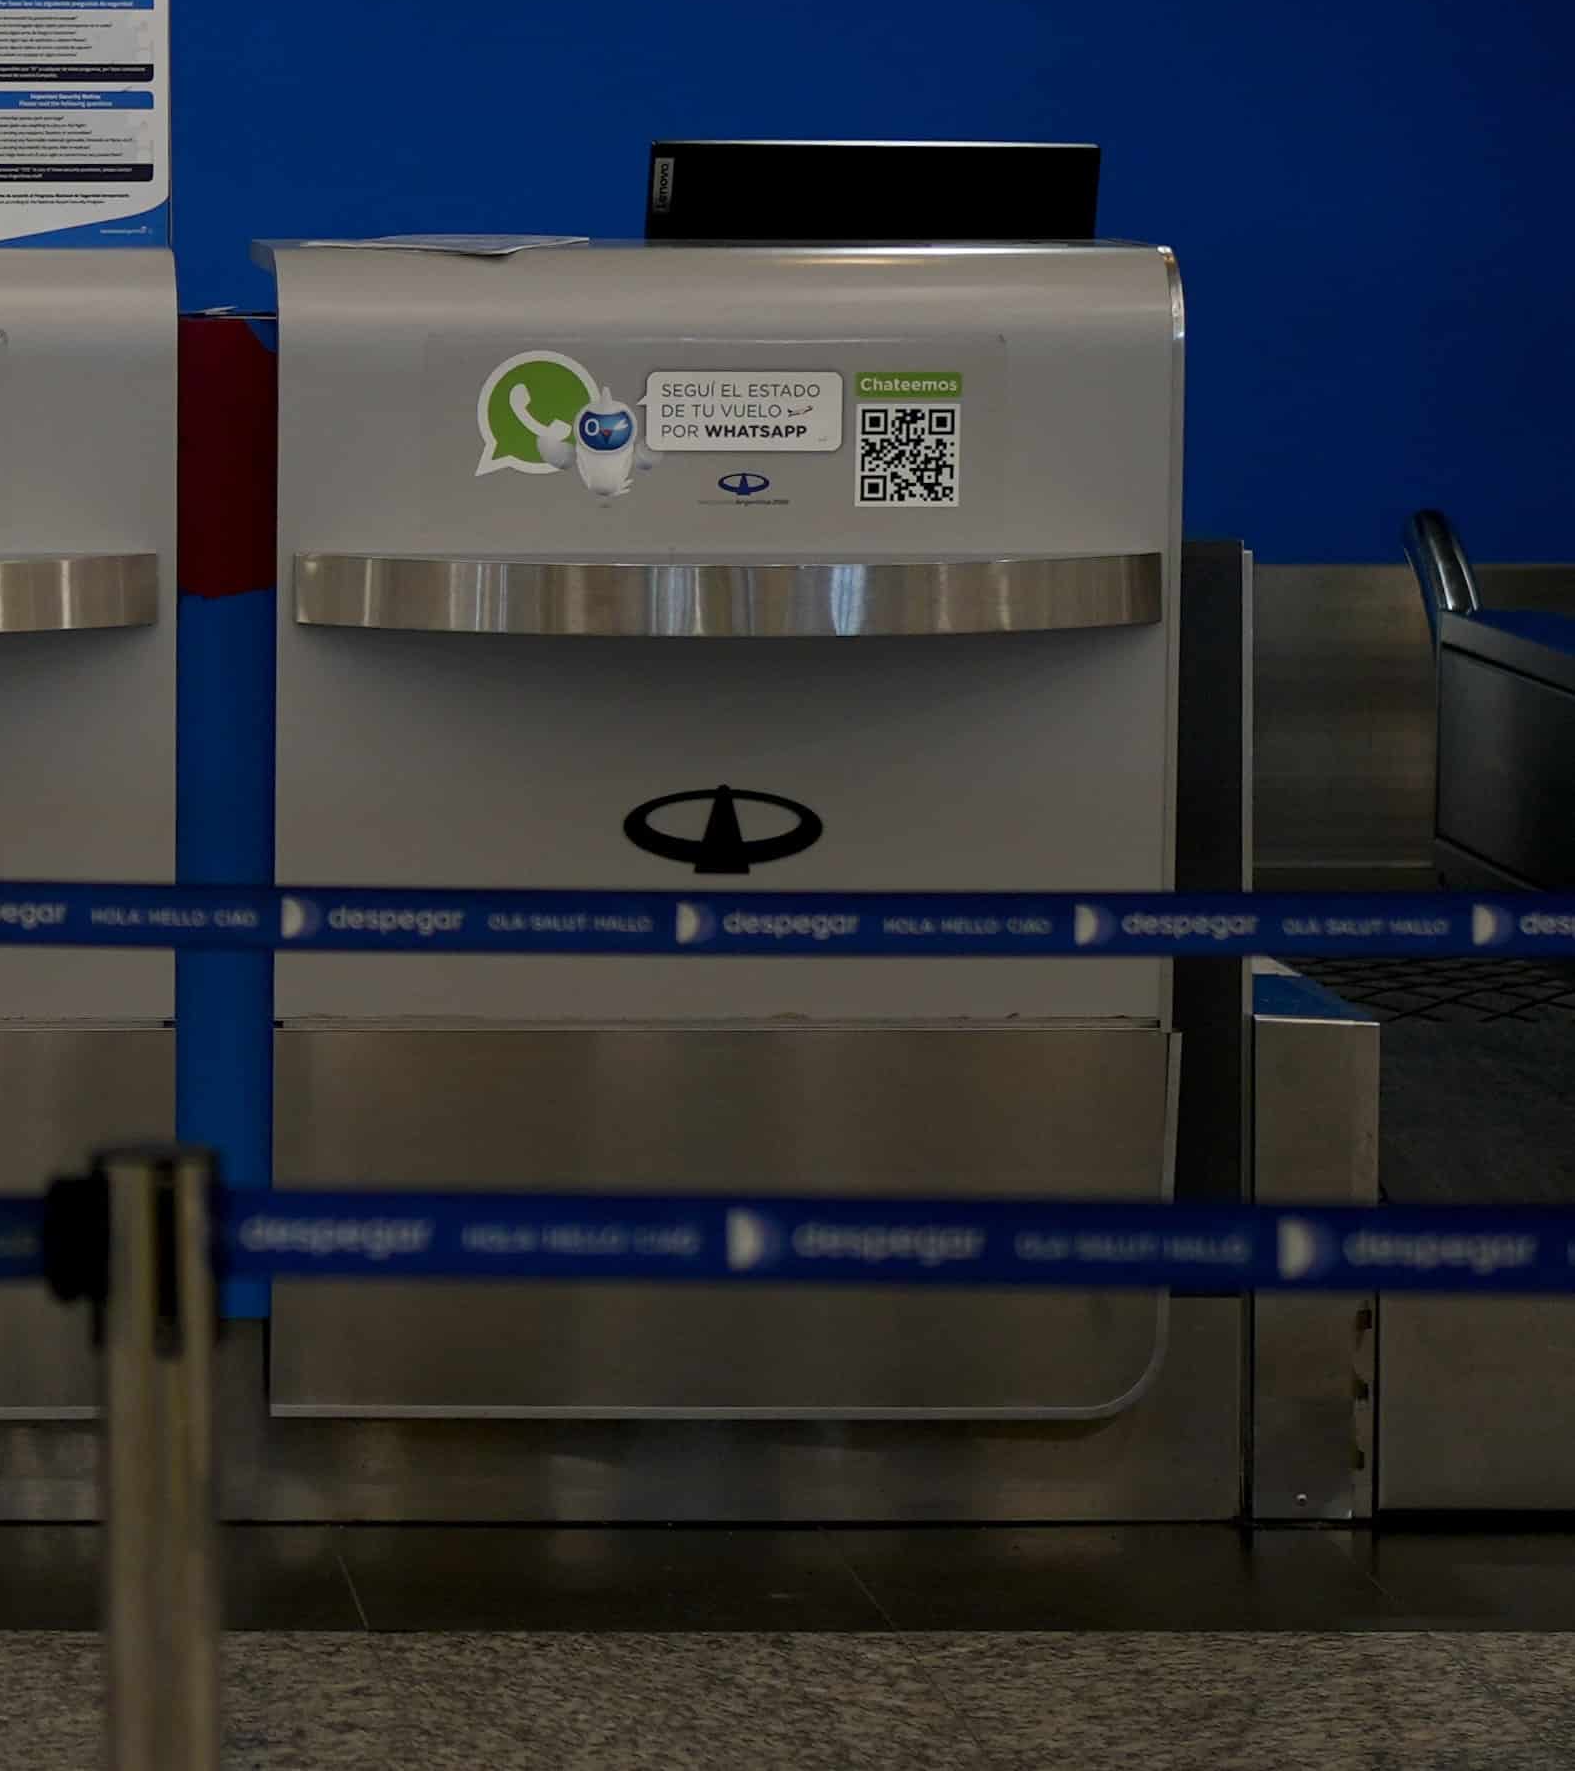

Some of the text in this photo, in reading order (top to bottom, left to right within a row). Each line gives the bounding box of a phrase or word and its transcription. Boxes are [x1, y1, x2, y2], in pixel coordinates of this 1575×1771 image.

[661, 382, 821, 399] SEGUÍ EL ESTADO
[860, 375, 957, 394] Chateemos
[661, 404, 782, 419] DE TU VUELO
[662, 424, 807, 439] POR WHATSAPP
[328, 907, 464, 936] despegar
[723, 912, 860, 940] despegar
[1122, 914, 1258, 940] despegar
